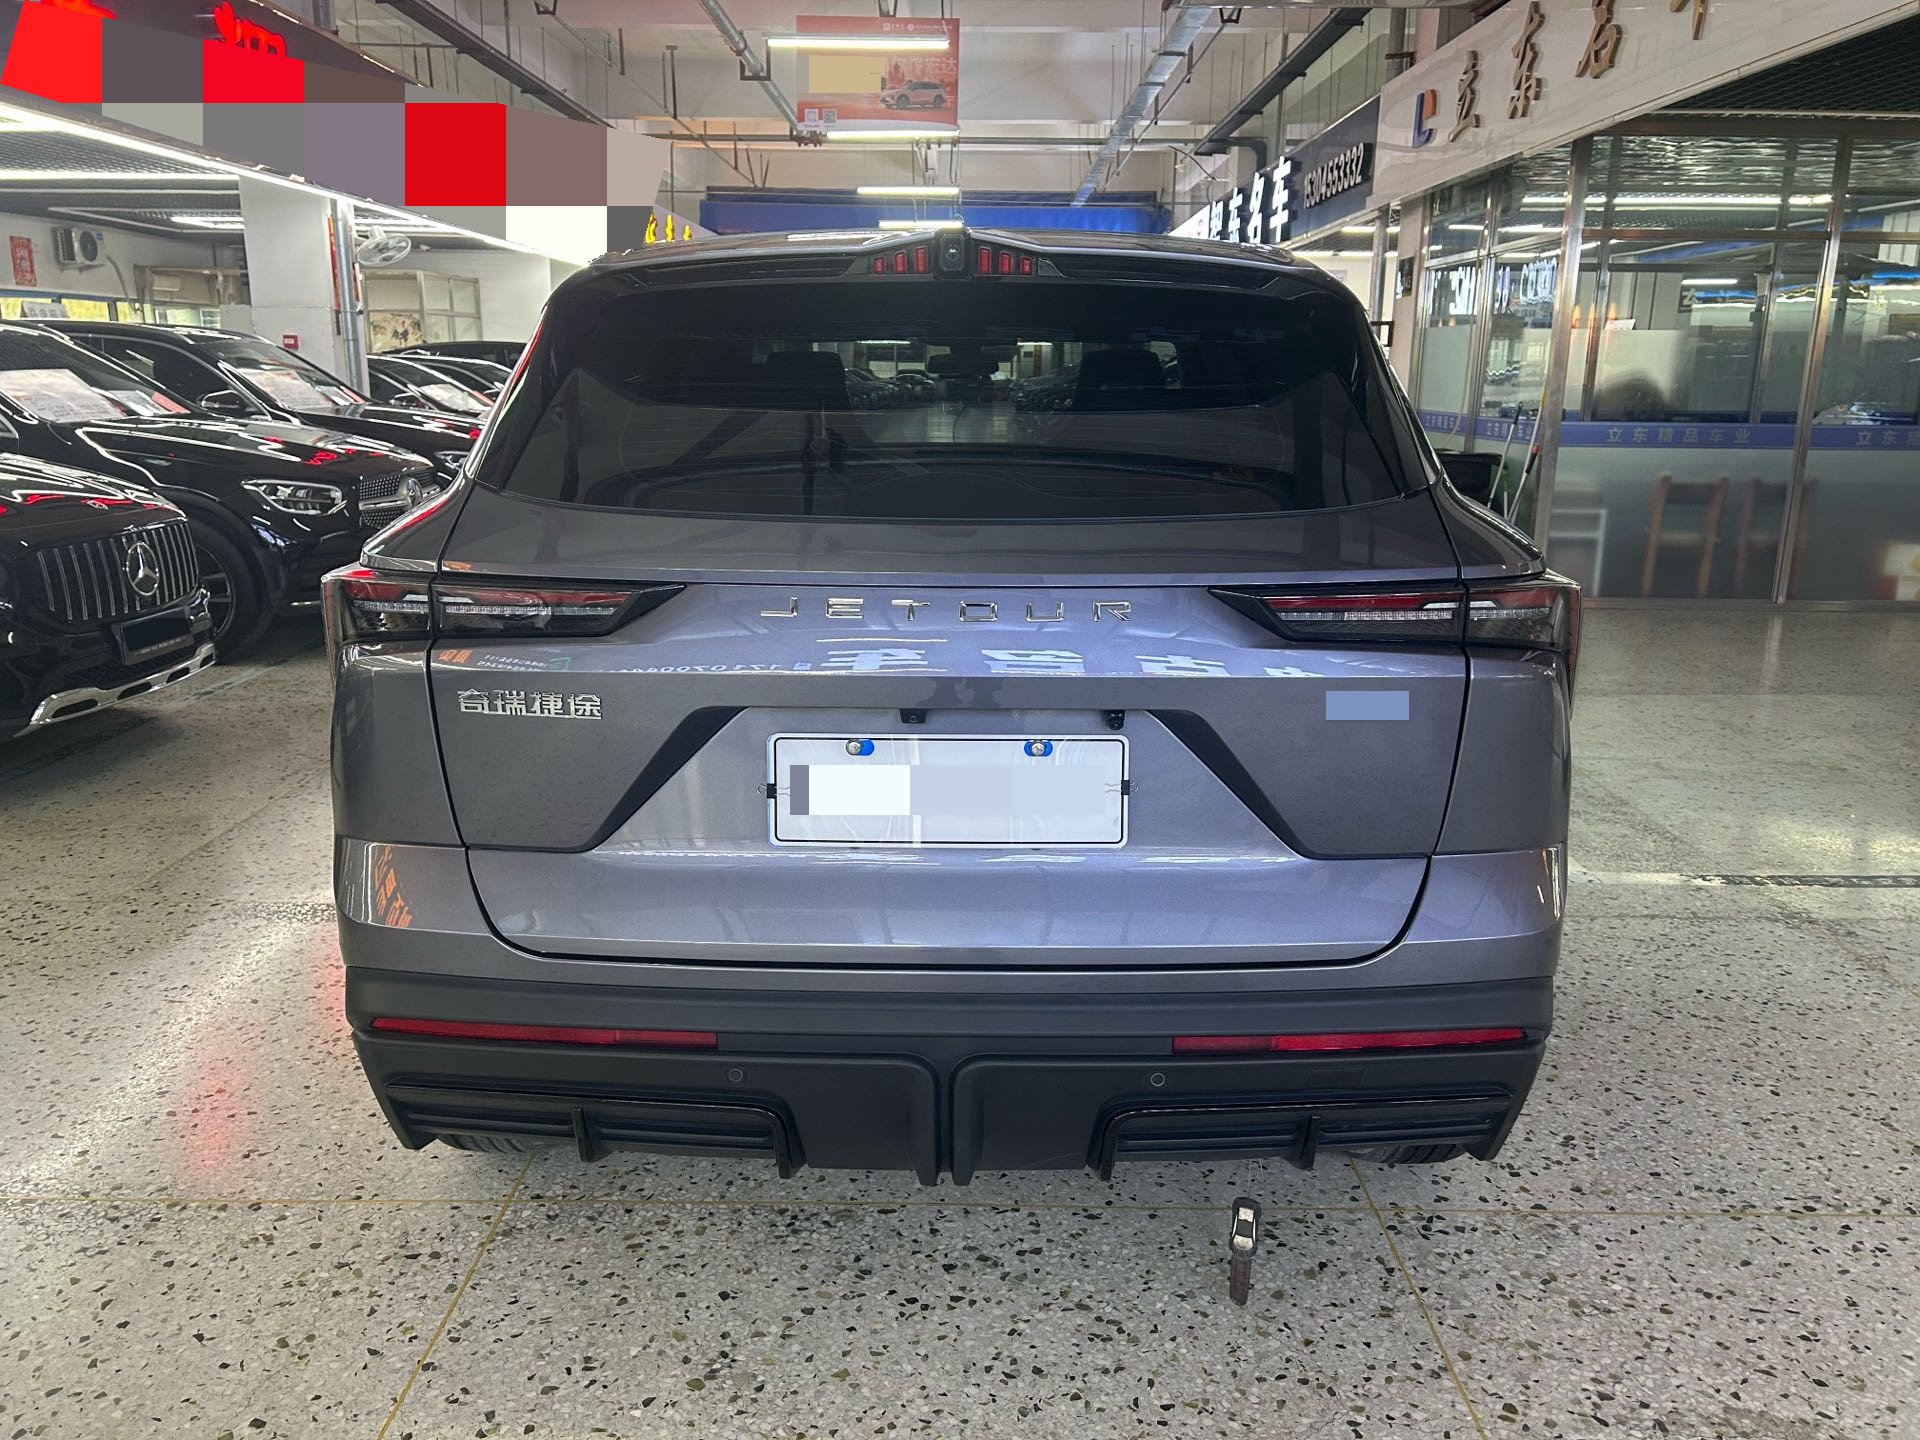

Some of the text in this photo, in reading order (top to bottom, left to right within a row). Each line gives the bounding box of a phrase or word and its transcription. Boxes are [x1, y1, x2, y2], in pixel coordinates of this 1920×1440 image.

[1450, 0, 1707, 143] 立东名
[1303, 142, 1364, 209] 15304553332
[1607, 426, 1751, 444] 立东精品车业
[760, 596, 1133, 622] JETOUR
[457, 688, 602, 719] 奇瑞捷途
